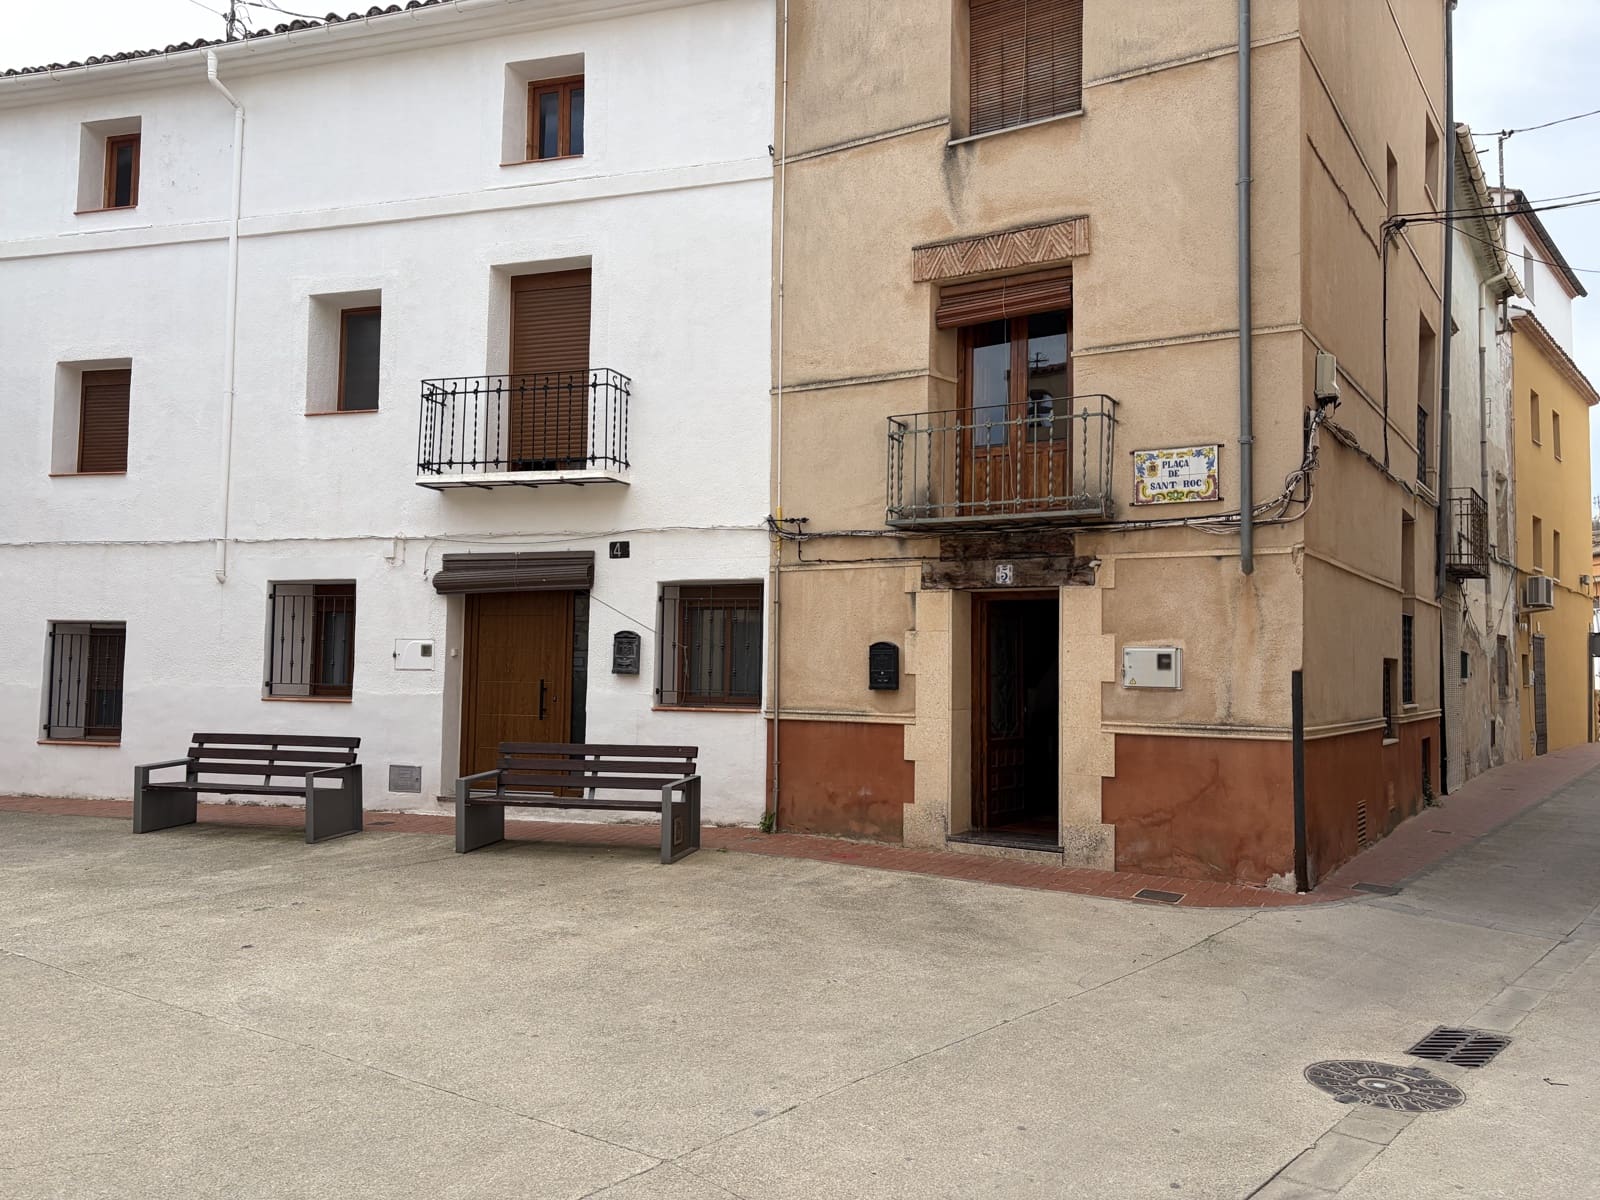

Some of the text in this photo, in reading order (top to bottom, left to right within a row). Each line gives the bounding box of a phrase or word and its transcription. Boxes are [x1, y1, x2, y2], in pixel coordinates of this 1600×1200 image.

[1162, 459, 1189, 469] PLAÇA
[1168, 469, 1180, 478] DE
[1150, 479, 1202, 491] SANT ROC
[613, 542, 622, 557] 4
